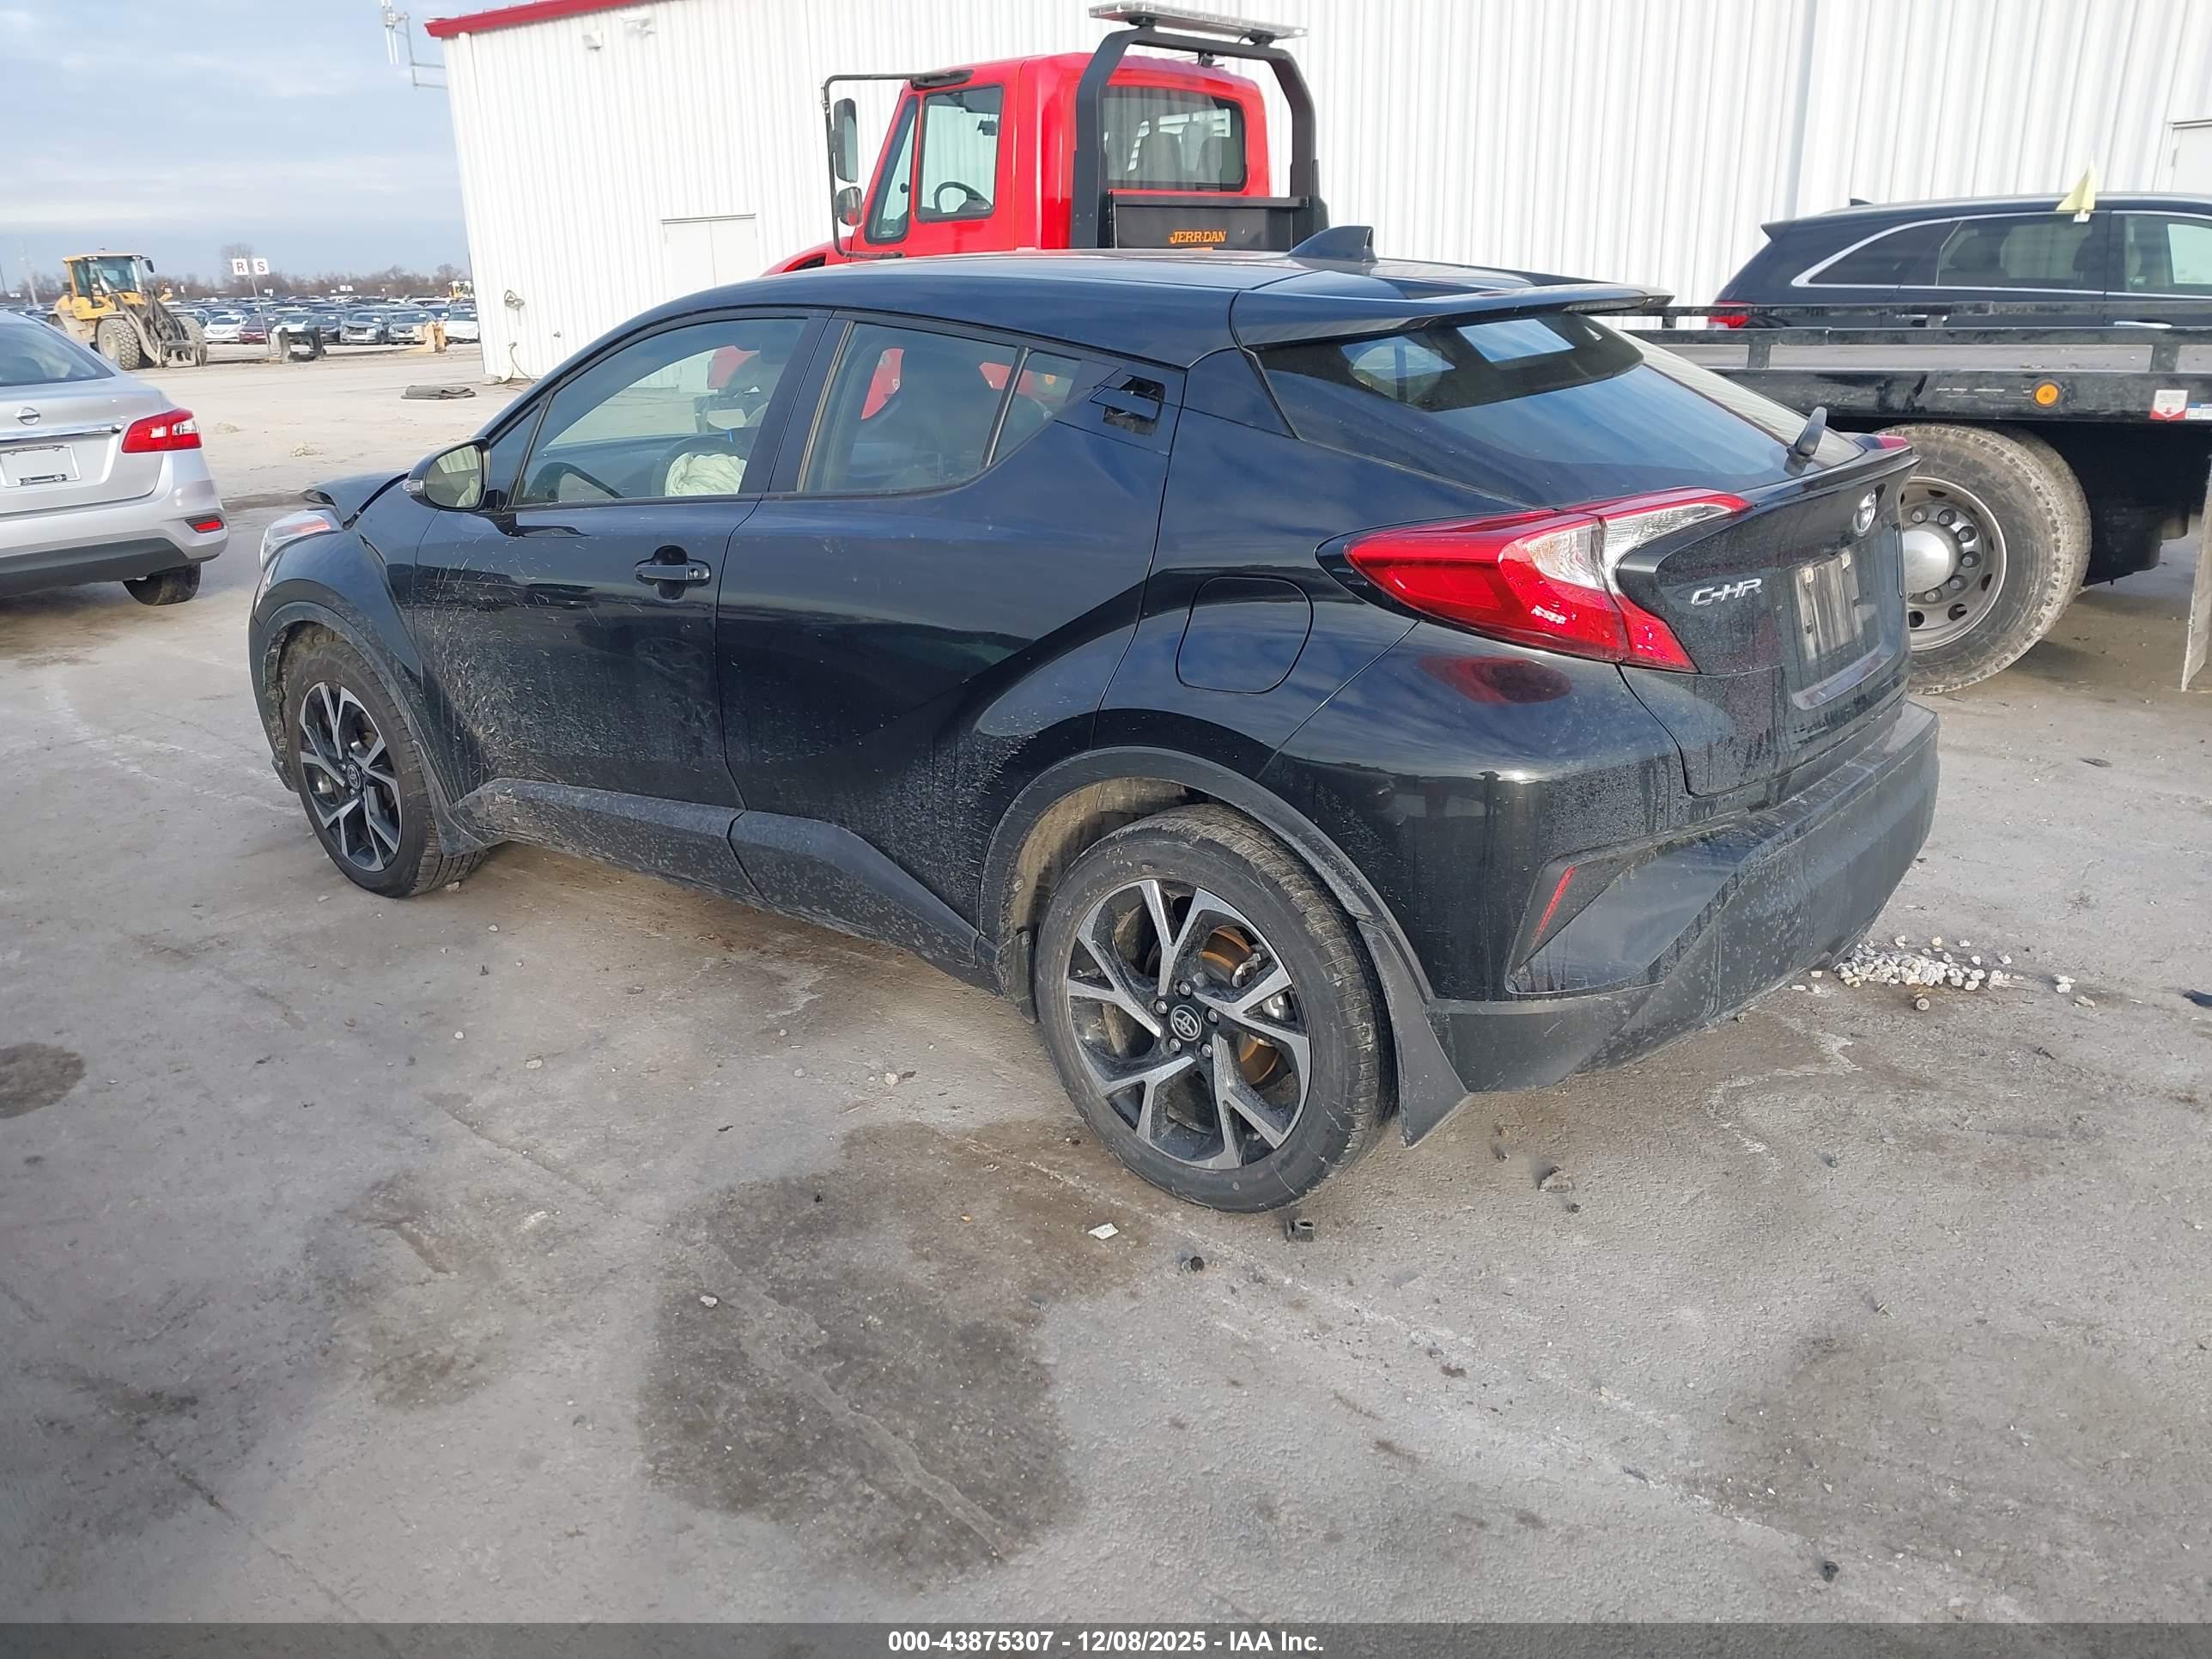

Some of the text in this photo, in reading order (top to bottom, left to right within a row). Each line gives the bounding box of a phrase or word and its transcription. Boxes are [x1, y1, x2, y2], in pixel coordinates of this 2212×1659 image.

[236, 262, 246, 272] R
[257, 261, 266, 272] S
[1691, 578, 1762, 606] C-HR
